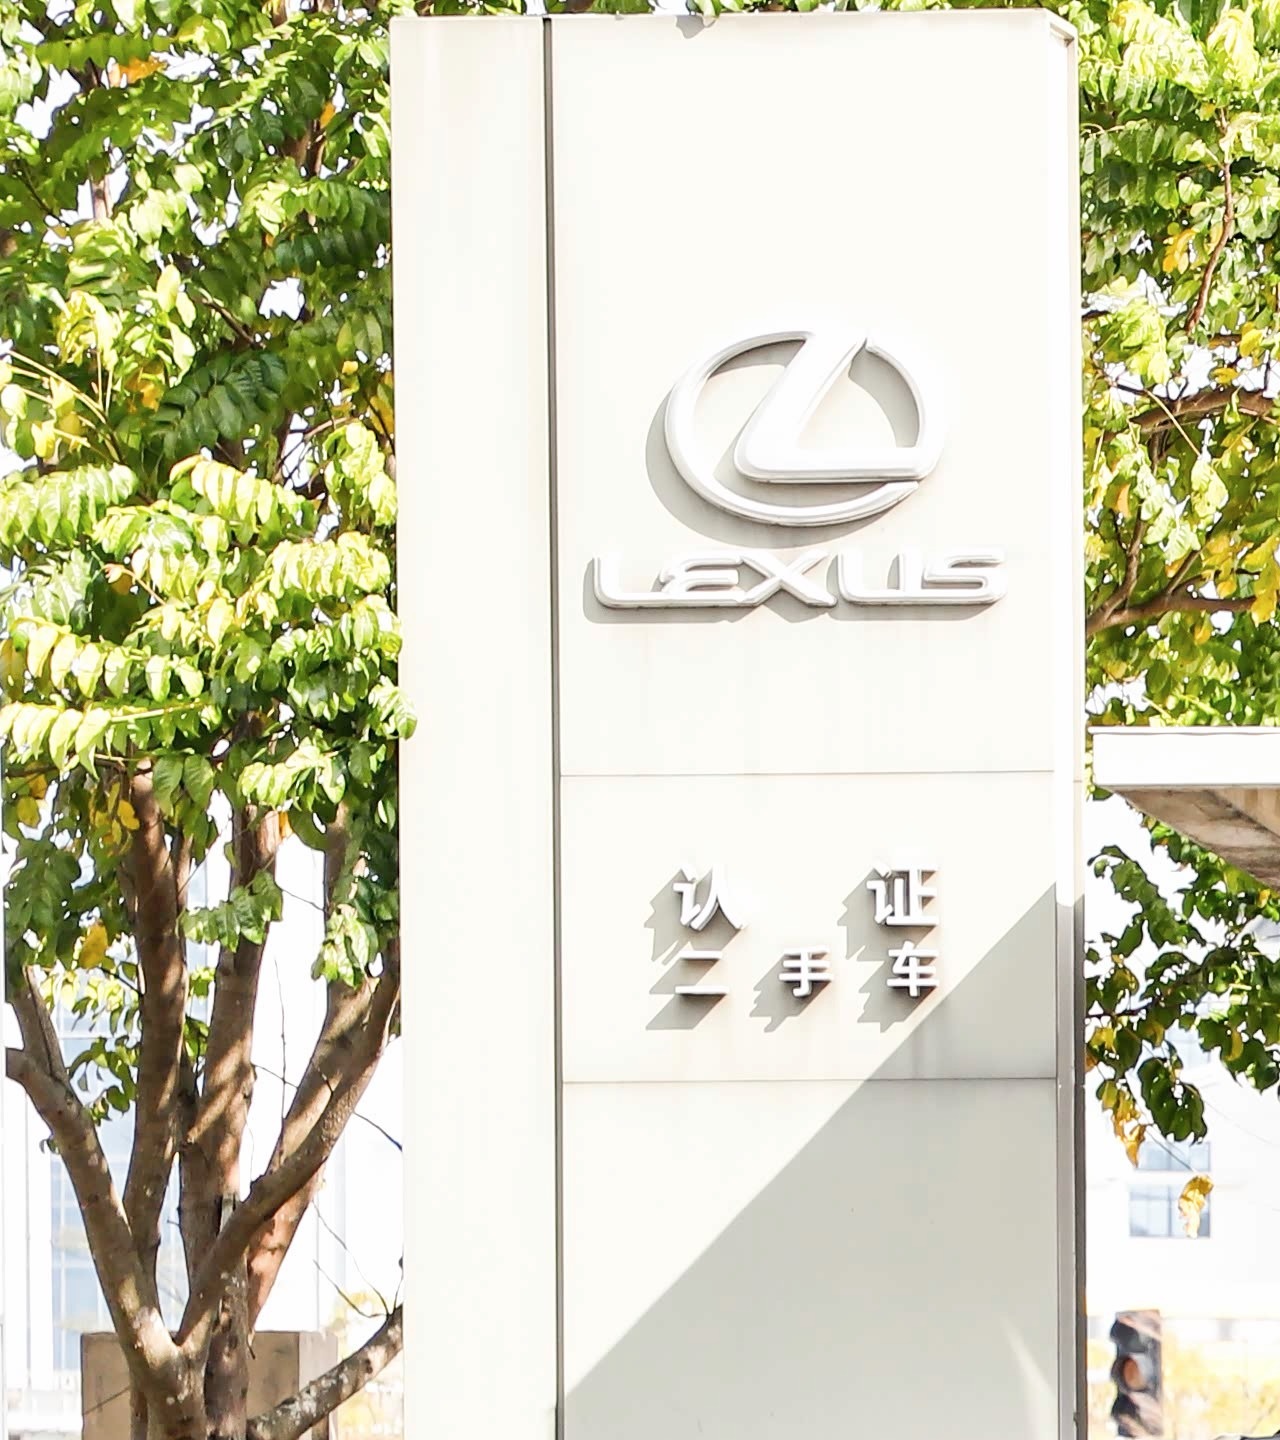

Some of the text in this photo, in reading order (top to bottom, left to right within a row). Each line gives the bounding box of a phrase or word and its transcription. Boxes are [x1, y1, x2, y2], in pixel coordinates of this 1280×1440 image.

[593, 549, 1007, 607] LEXUS
[672, 862, 942, 931] 认证
[674, 940, 940, 997] 二手车
